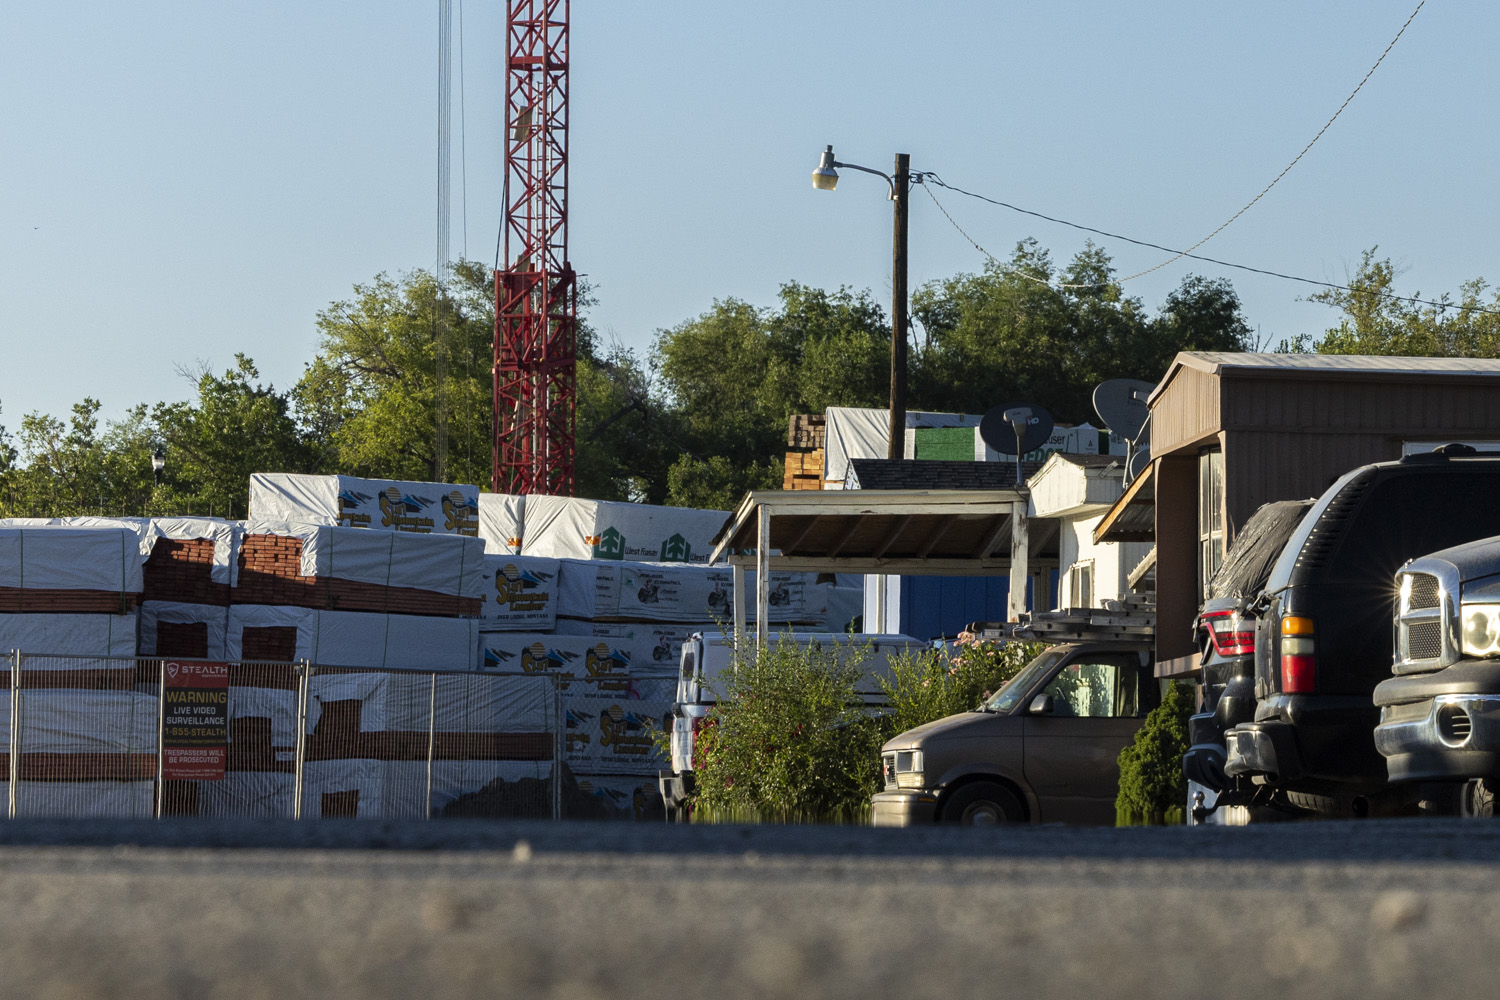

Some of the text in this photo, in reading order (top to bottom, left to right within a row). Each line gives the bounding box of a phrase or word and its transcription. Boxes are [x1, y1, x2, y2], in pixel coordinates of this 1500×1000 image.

[1027, 417, 1040, 425] HD
[625, 546, 658, 557] West Fraser
[690, 553, 723, 563] West Frer
[510, 601, 545, 611] Lumber
[181, 665, 228, 674] STEALTH
[166, 690, 227, 704] WARNING
[173, 706, 216, 715] LIVE VIDEO
[166, 716, 225, 725] SURVEILLANCE
[164, 727, 226, 737] 1-855-STEALTH
[164, 749, 224, 757] TRESPASSERS WILL
[168, 756, 219, 764] BE PROSECUTED
